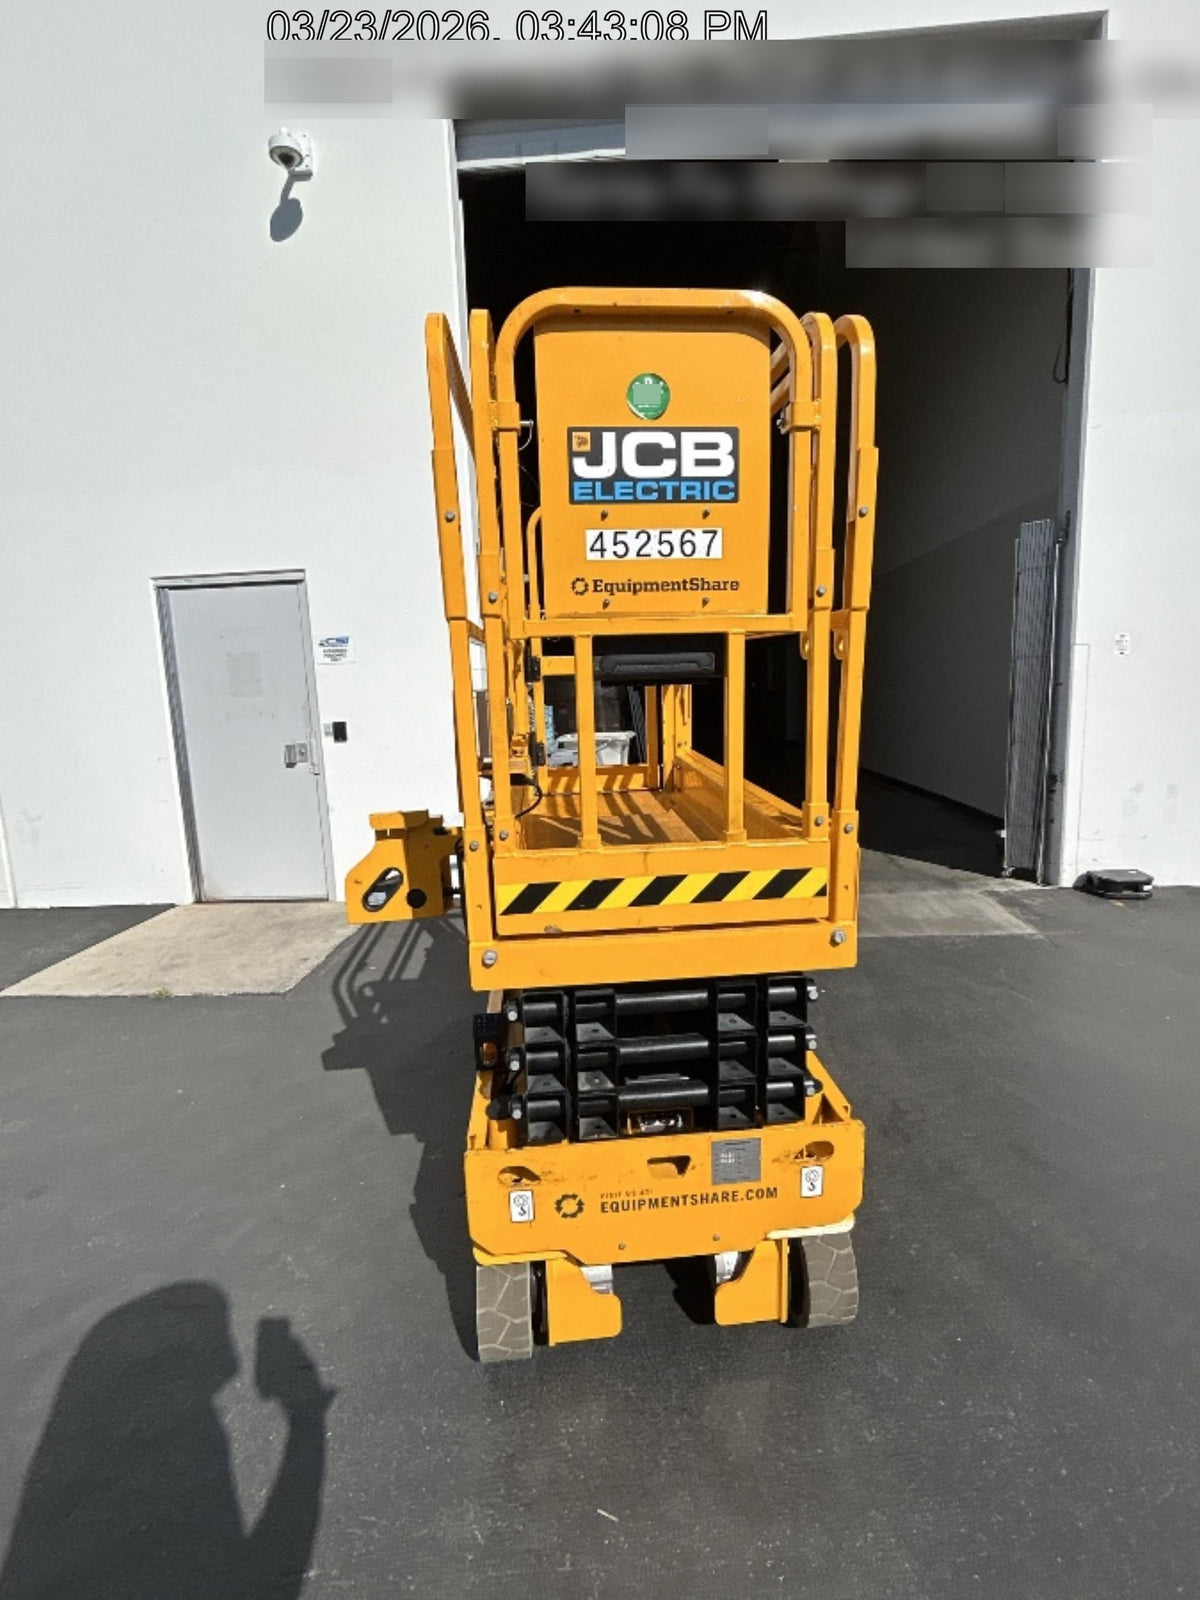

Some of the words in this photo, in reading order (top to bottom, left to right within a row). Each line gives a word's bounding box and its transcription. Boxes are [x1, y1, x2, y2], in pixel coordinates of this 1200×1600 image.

[572, 431, 735, 479] JCB
[573, 481, 735, 501] ELECTRIC
[590, 529, 718, 559] 452567
[592, 577, 740, 596] EquipmentShare
[600, 1187, 778, 1214] EQUIPMENTSHARE.COM
